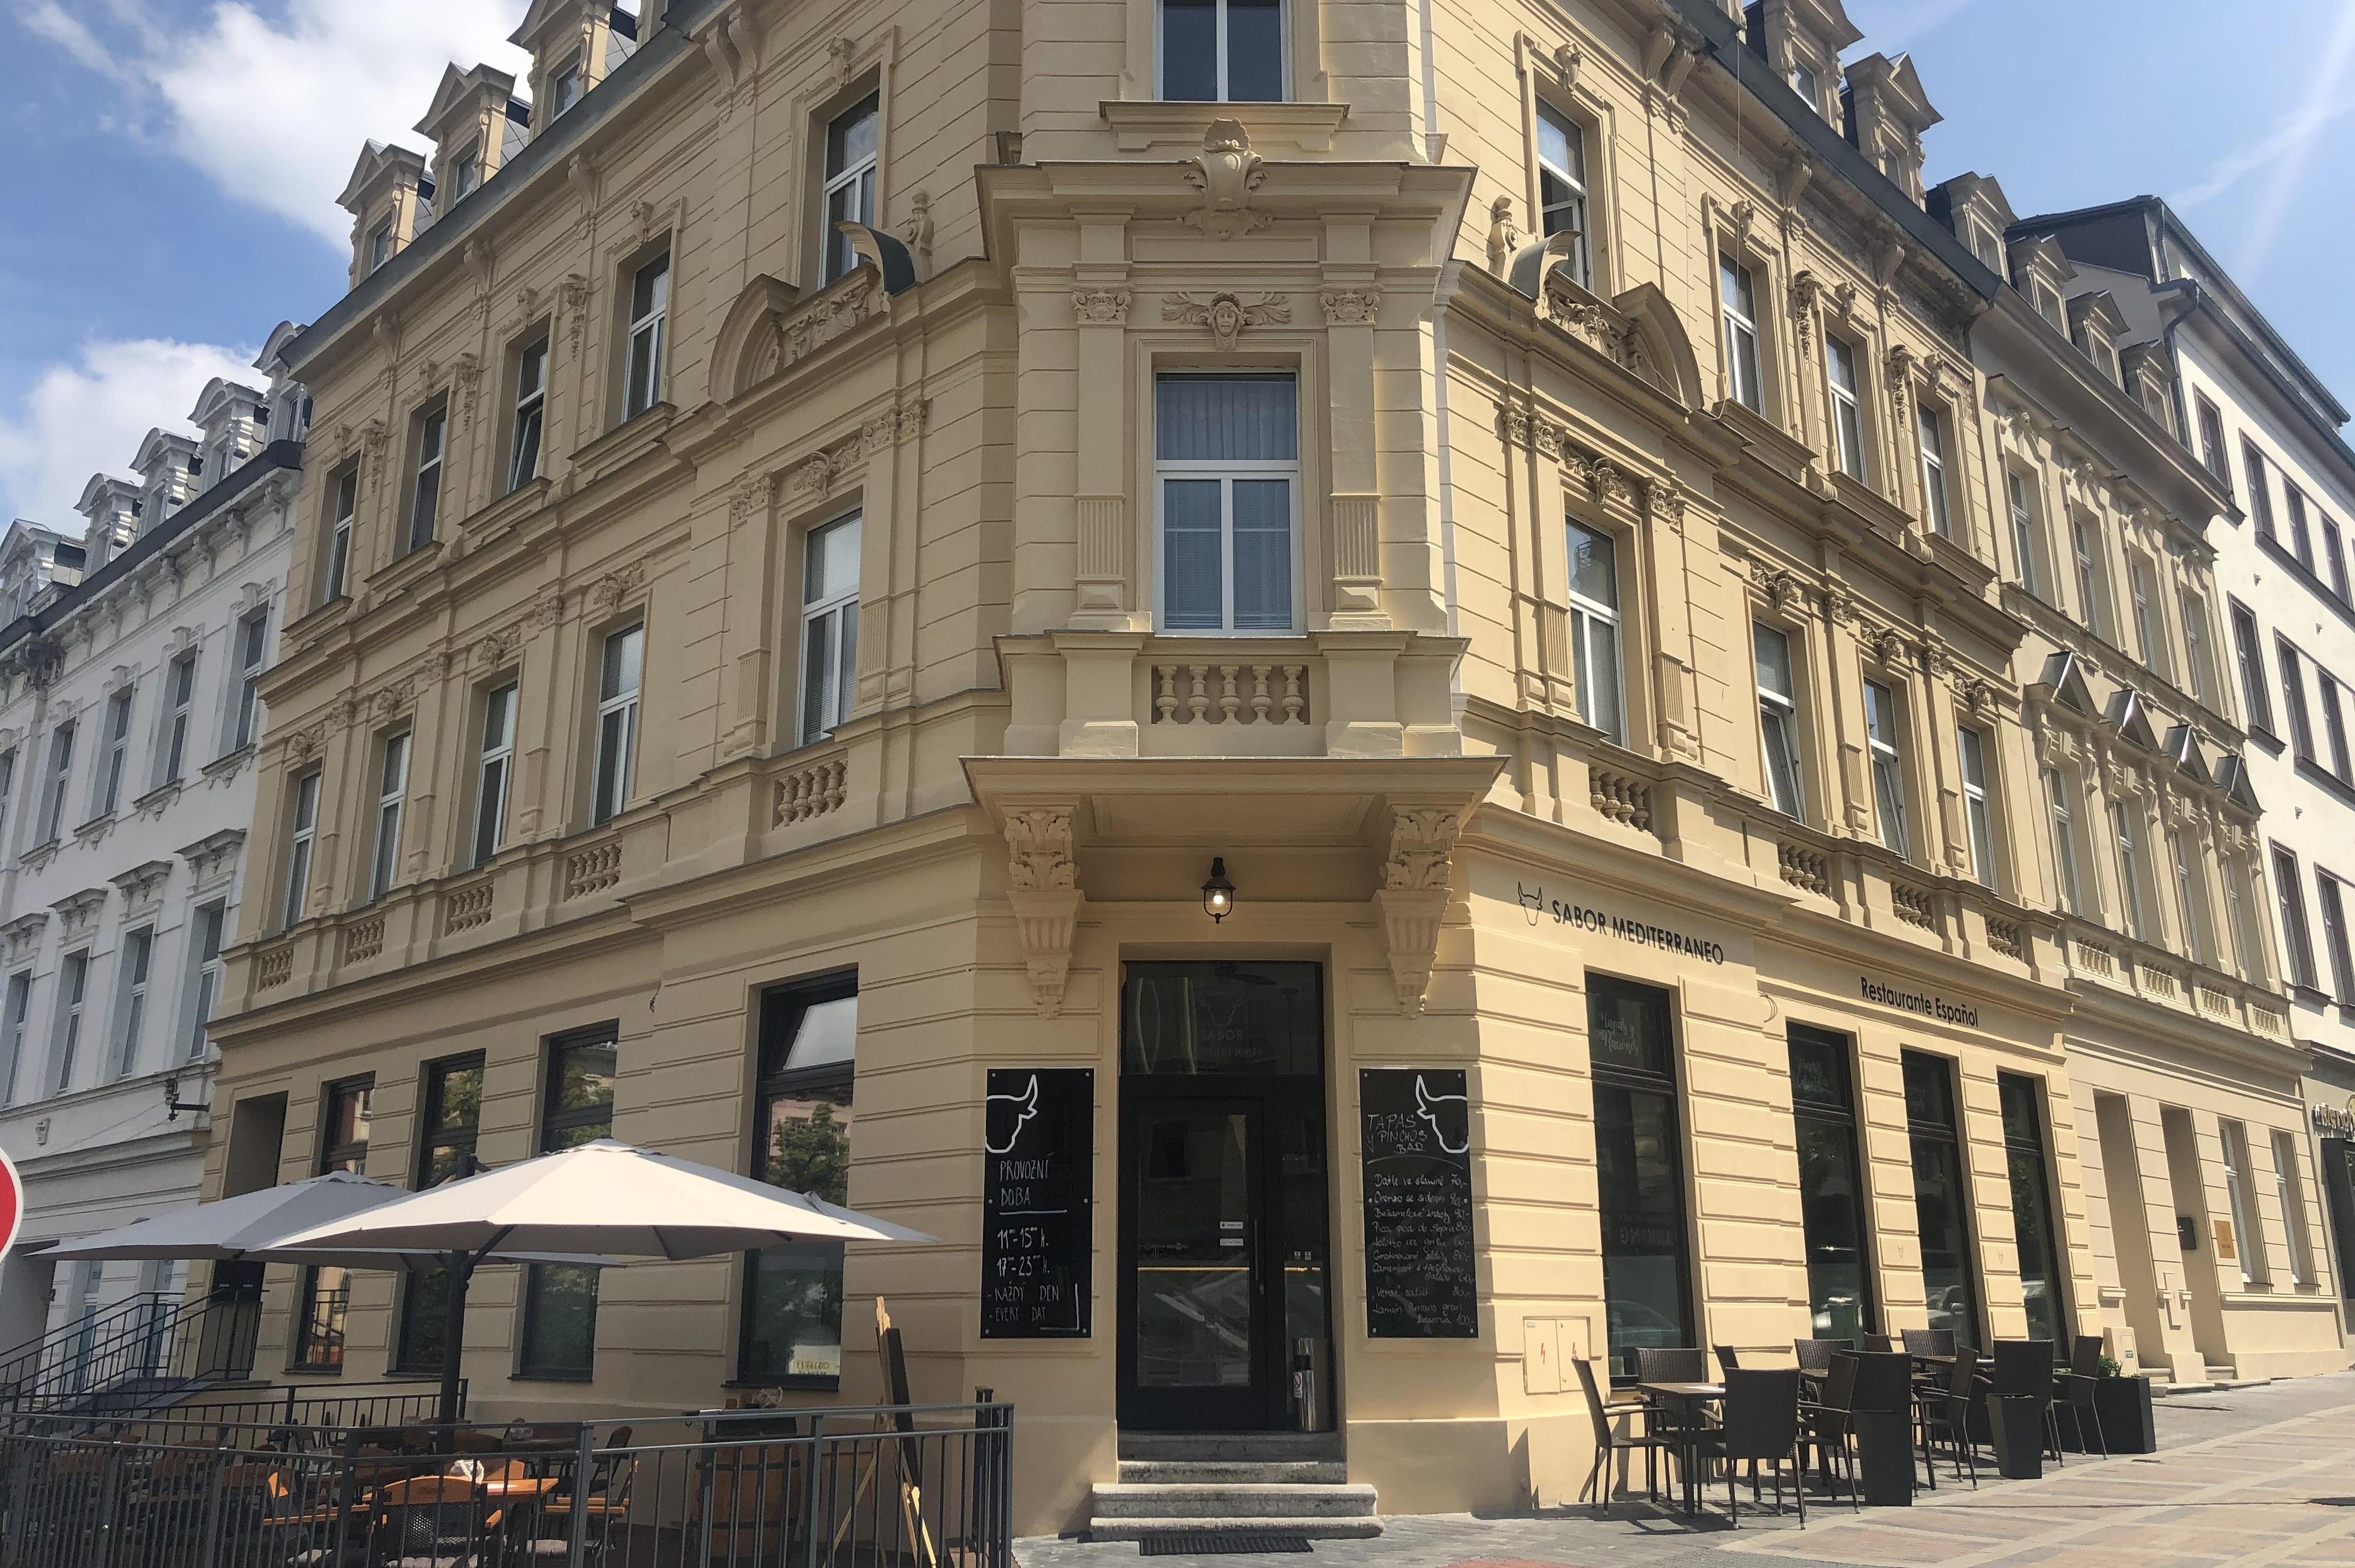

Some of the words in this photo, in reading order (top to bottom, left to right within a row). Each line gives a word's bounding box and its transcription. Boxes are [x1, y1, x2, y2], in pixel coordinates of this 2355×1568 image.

[1553, 900, 1607, 935] SABOR
[1613, 916, 1724, 965] MEDITERRANEO
[1860, 976, 1932, 1015] Restaurante
[1935, 997, 1979, 1028] Español
[1367, 1112, 1416, 1130] TAPAS
[1376, 1130, 1428, 1143] PINCHOS
[1375, 1173, 1398, 1187] Datle
[1001, 1186, 1030, 1207] DOBA
[1040, 1284, 1059, 1301] DEN
[996, 1305, 1019, 1322] EVERY
[1031, 1305, 1046, 1323] DAY
